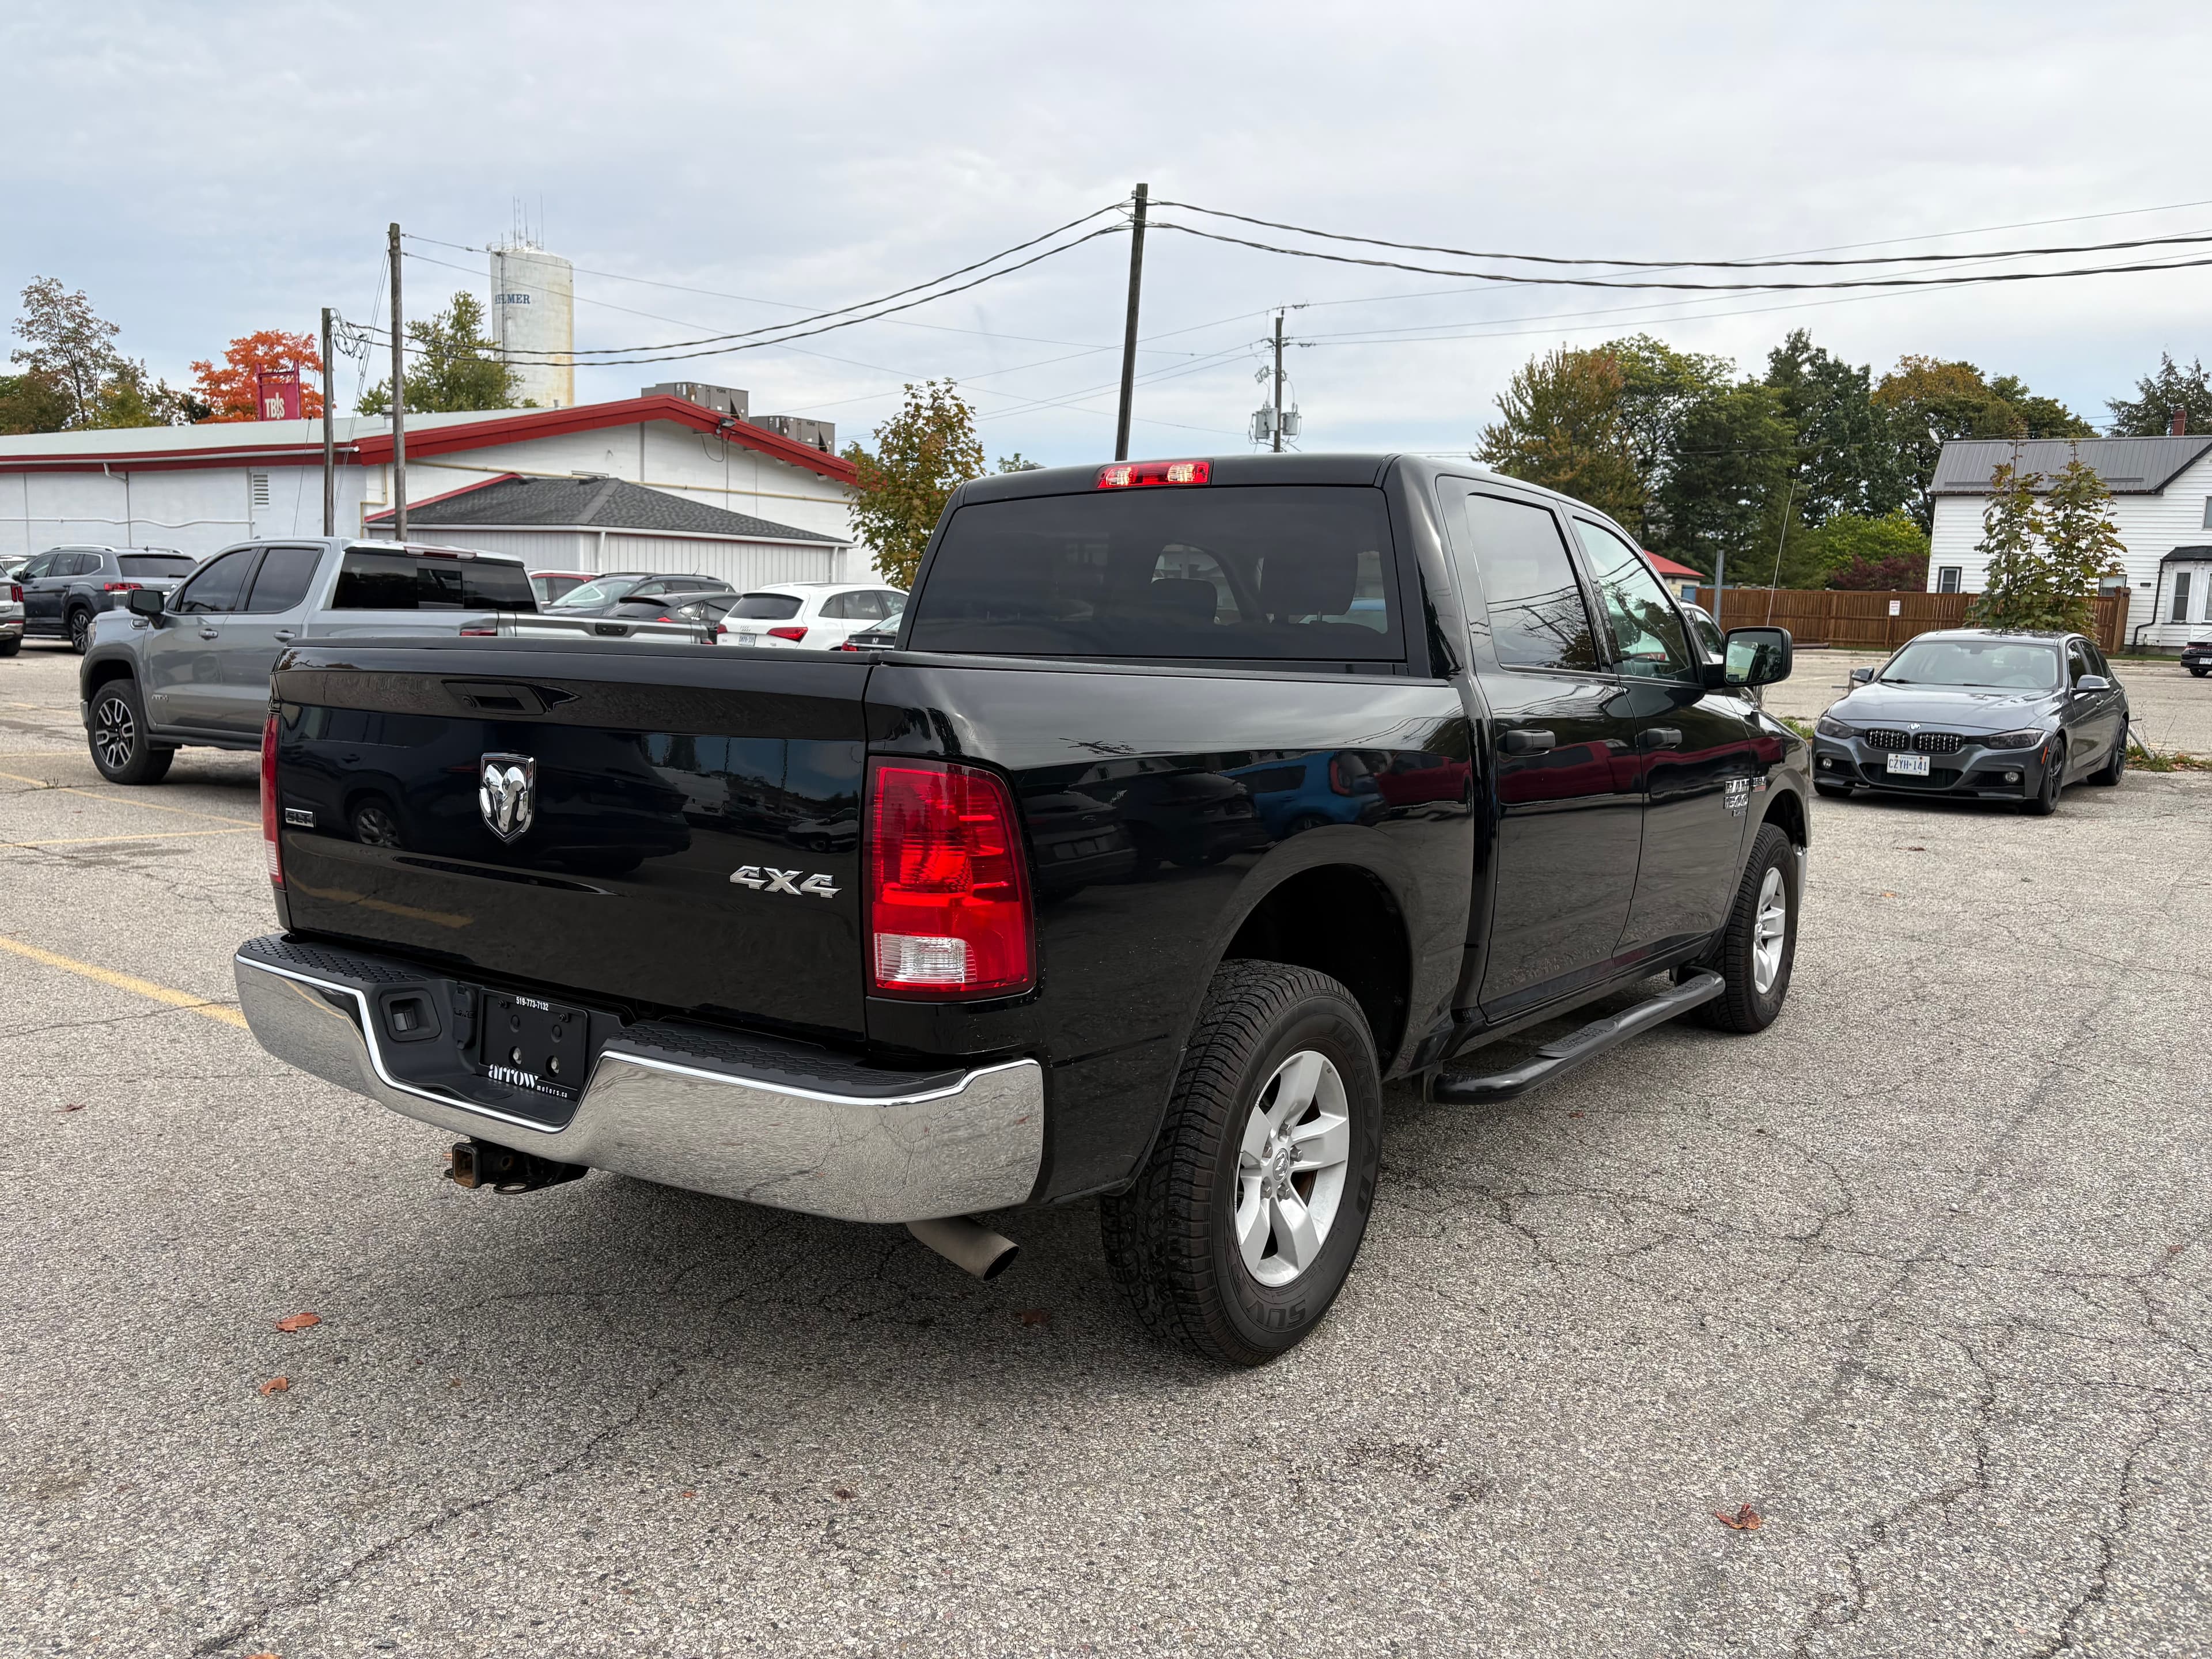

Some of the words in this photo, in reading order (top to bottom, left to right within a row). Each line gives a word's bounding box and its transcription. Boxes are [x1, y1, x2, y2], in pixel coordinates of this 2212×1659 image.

[1889, 758, 1908, 770] CZYH
[1913, 760, 1927, 771] 141
[516, 997, 549, 1012] 519-773-7132
[488, 1064, 539, 1089] arrow
[536, 1085, 568, 1099] motors.ca
